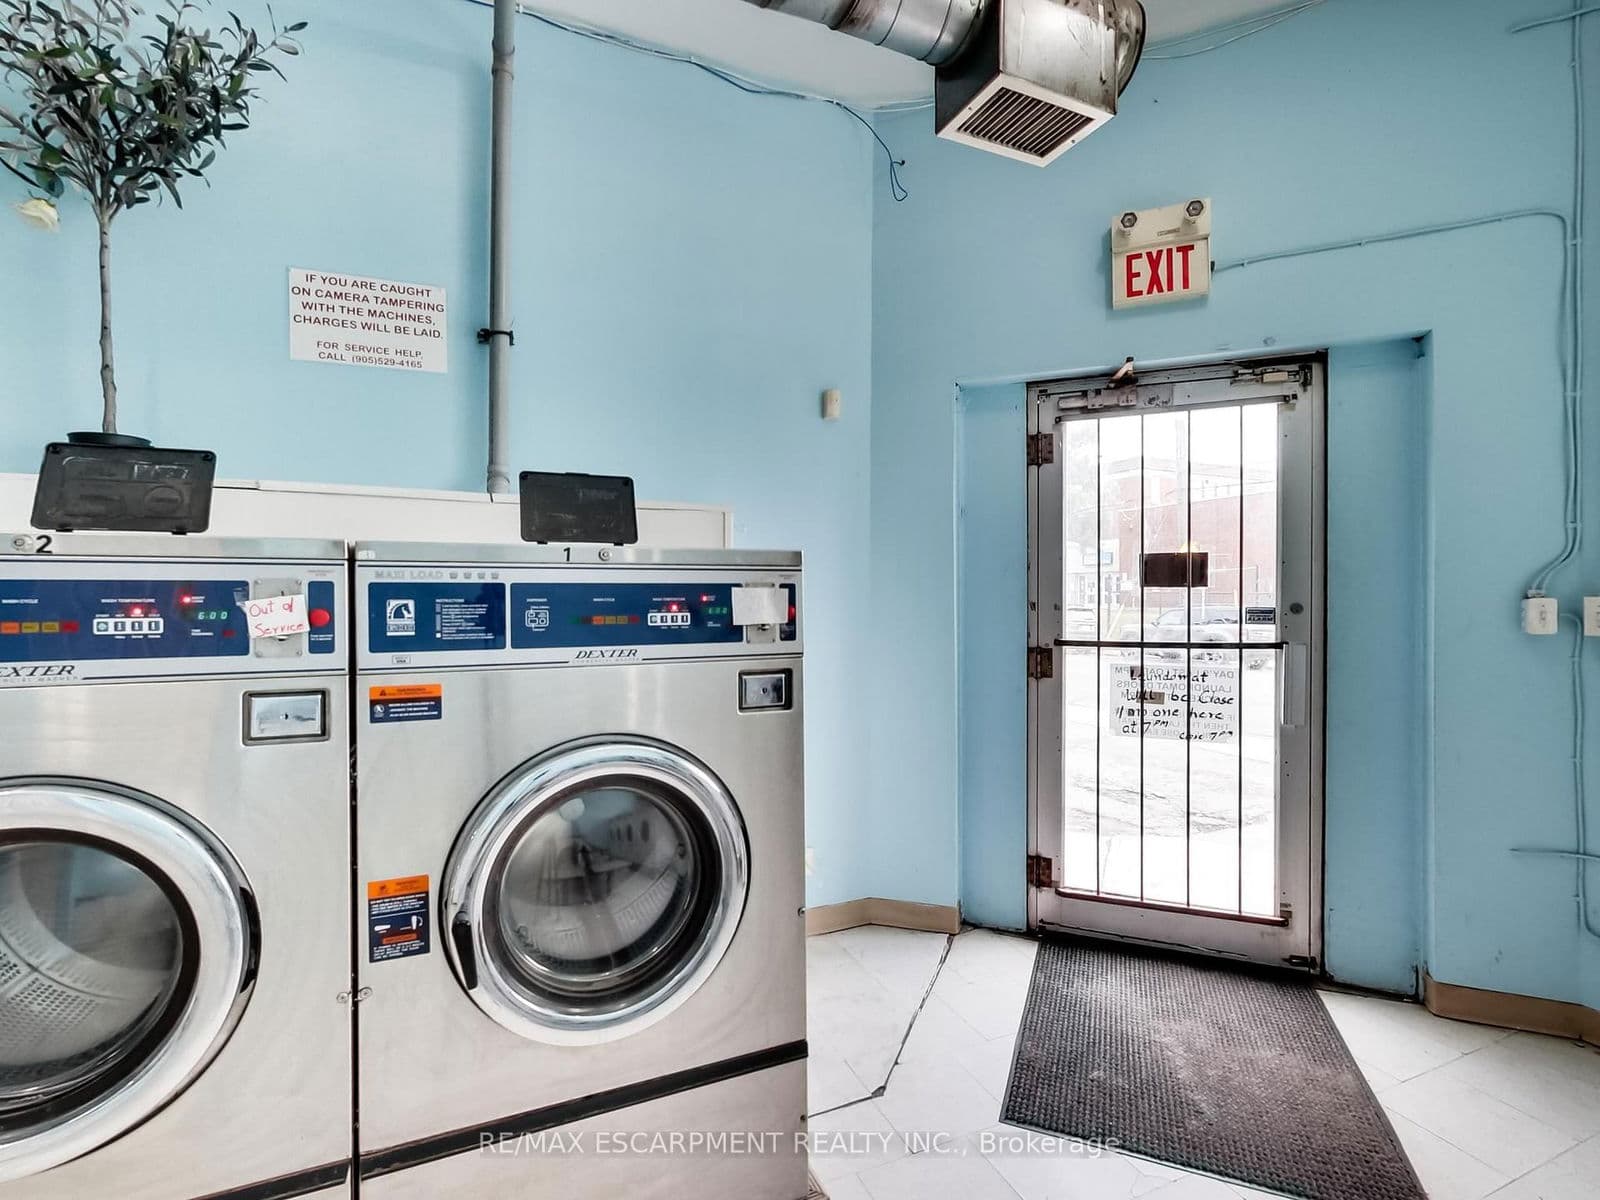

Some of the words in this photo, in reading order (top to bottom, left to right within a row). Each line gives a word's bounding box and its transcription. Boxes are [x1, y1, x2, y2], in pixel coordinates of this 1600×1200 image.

[1126, 244, 1195, 298] EXIT
[305, 273, 317, 283] IF
[320, 275, 347, 287] YOU
[351, 280, 377, 291] ARE
[380, 283, 432, 298] CAUGHT
[291, 286, 311, 297] ON
[314, 290, 370, 304] CAMERA
[373, 295, 445, 313] TAMPERING
[301, 301, 335, 313] WITH
[338, 305, 364, 316] THE
[367, 309, 436, 326] MACHINES,
[293, 314, 357, 330] CHARGES
[360, 321, 391, 333] WILL
[394, 325, 410, 335] BE
[413, 327, 443, 339] LAID.
[316, 340, 339, 350] FOR
[344, 343, 390, 355] SERVICE
[318, 351, 346, 361] CALL
[351, 355, 423, 369] (905)529-4165
[35, 535, 53, 554] 2
[563, 547, 571, 562] 1
[250, 600, 274, 618] Out
[282, 597, 294, 613] of
[255, 622, 304, 637] Service
[575, 649, 638, 659] DEXTER
